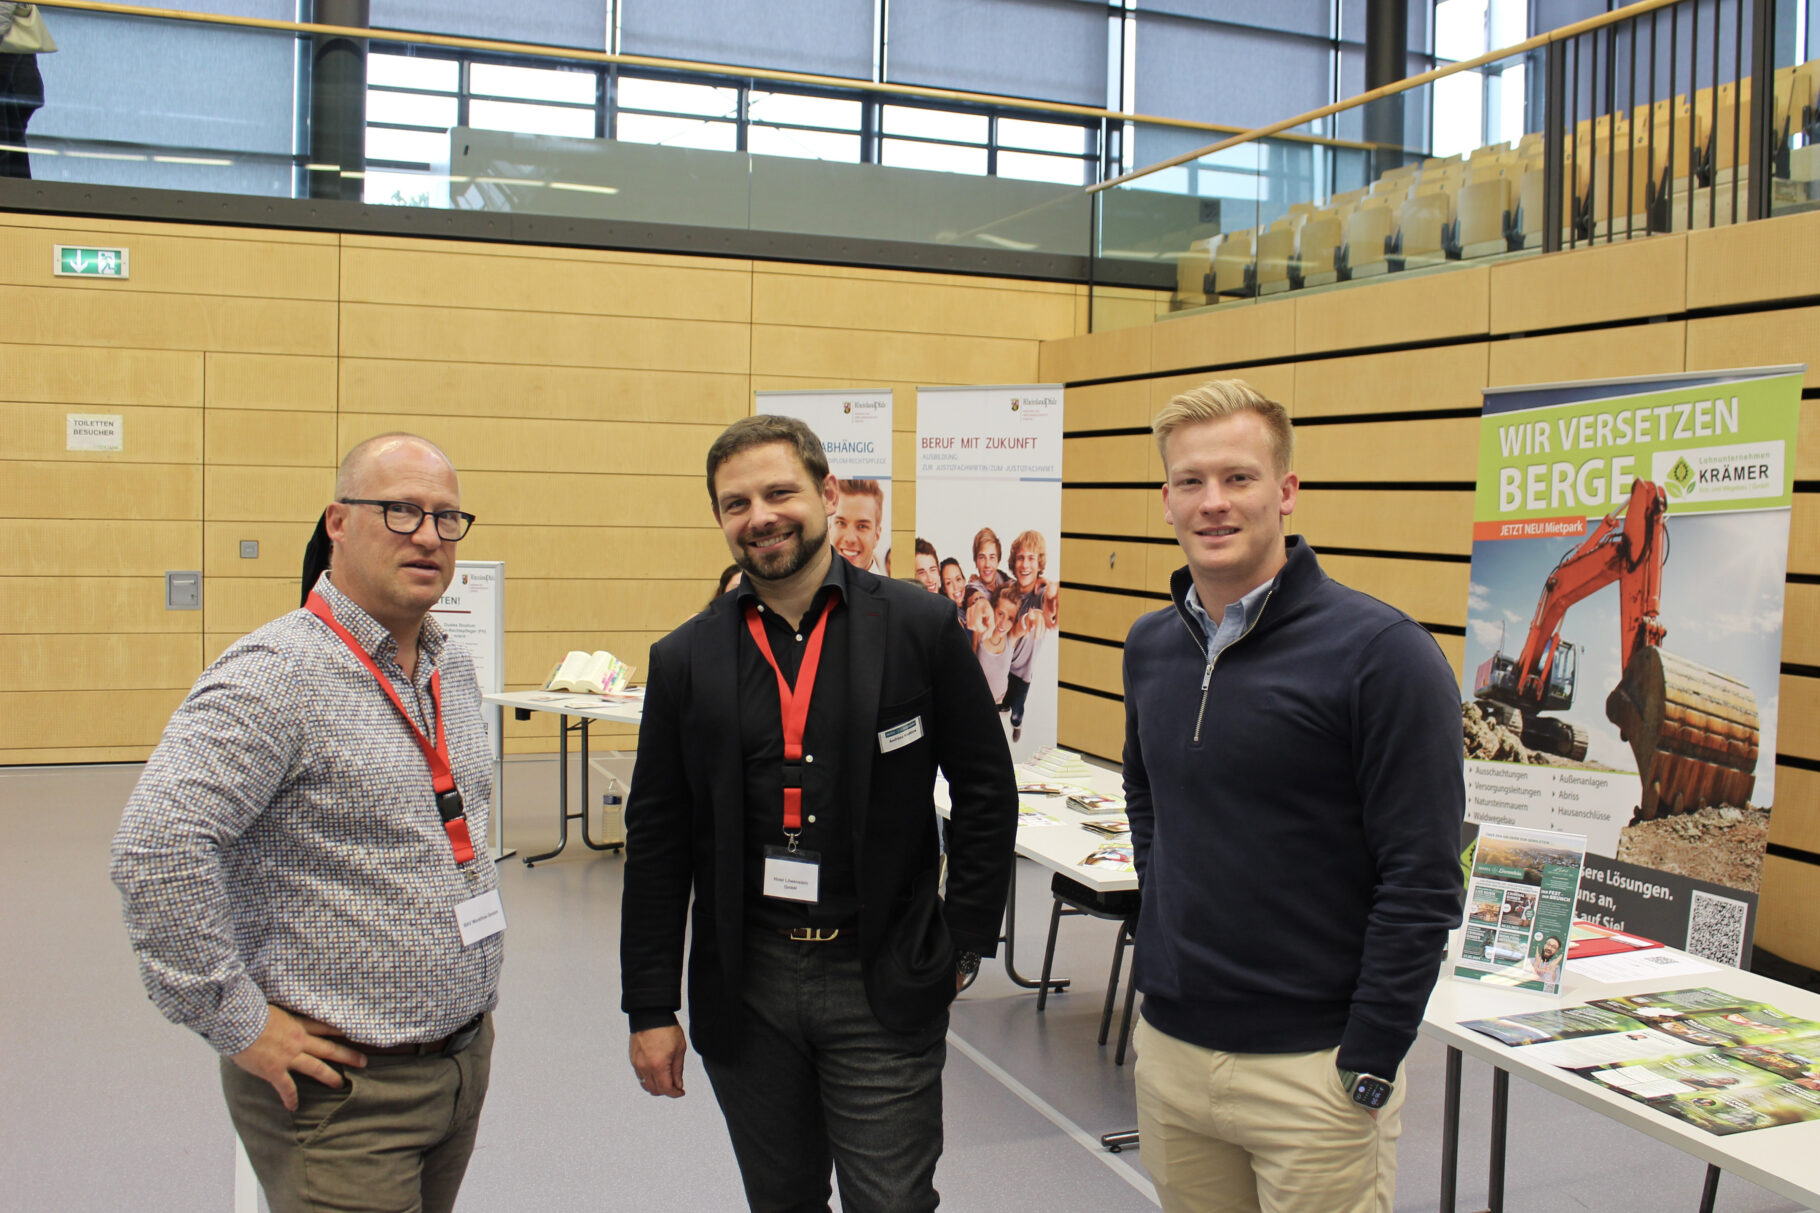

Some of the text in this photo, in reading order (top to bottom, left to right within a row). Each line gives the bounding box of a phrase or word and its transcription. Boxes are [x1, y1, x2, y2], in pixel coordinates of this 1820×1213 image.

[1499, 396, 1739, 457] WIR VERSETZEN
[921, 437, 1038, 449] BERUF MIT ZUKUNFT
[1699, 464, 1769, 483] KRÄMER
[1499, 455, 1636, 512] BERGE
[1500, 520, 1583, 536] JETZT NEU! Mietpark
[1475, 766, 1528, 780] Ausschachtungen
[1559, 774, 1609, 789] Außenanlagen
[1474, 782, 1542, 798] Versorgungsleitungen
[1558, 790, 1580, 801] Abriss
[1474, 797, 1528, 811] Natursteinmauern
[1474, 812, 1516, 825] Waldwegebau
[1558, 806, 1611, 821] Hausanschlüsse
[1606, 869, 1674, 901] Lösungen.
[1598, 894, 1616, 912] an,
